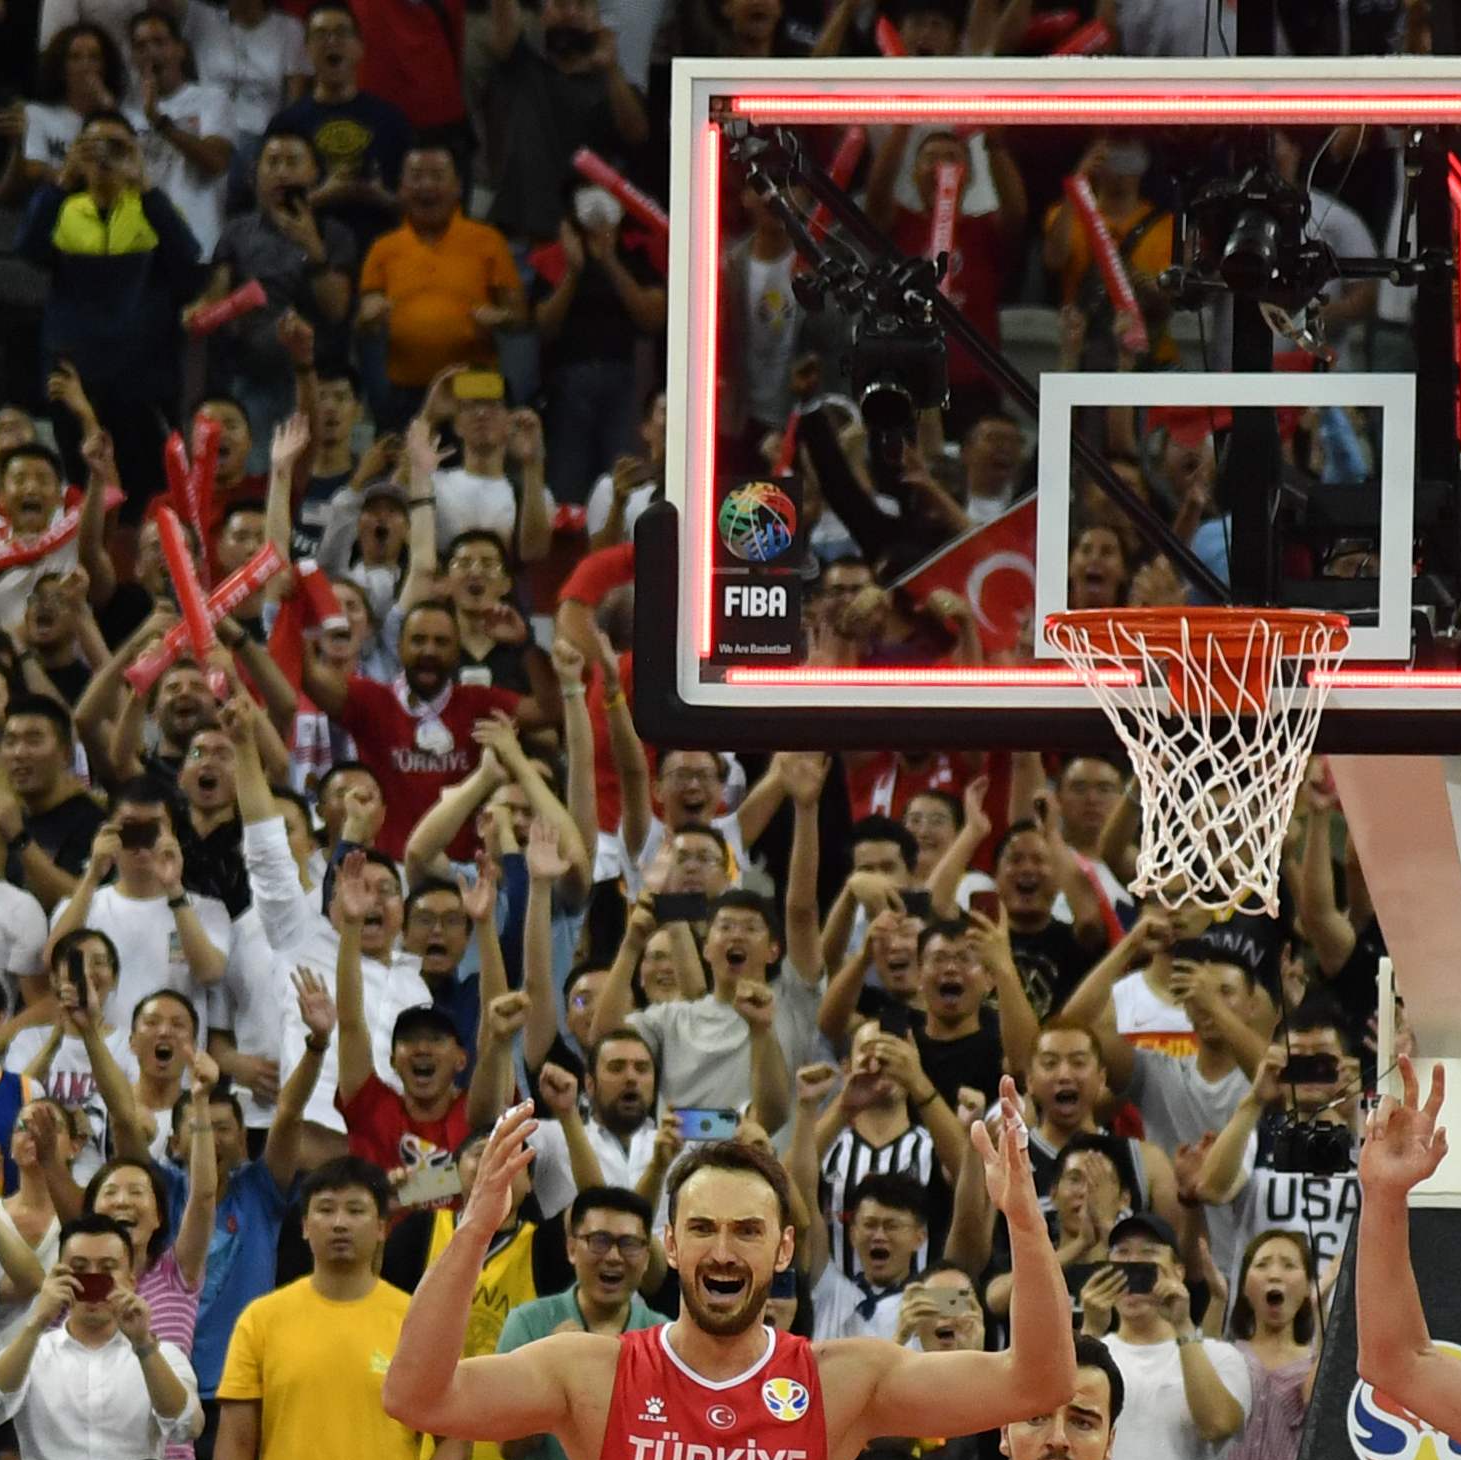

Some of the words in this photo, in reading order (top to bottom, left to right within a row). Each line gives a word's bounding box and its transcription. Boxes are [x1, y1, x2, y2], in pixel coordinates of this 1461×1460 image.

[724, 585, 787, 617] FIBA
[718, 644, 733, 654] We
[734, 644, 749, 654] Are
[750, 644, 791, 655] Basketball
[1267, 1177, 1363, 1223] USA
